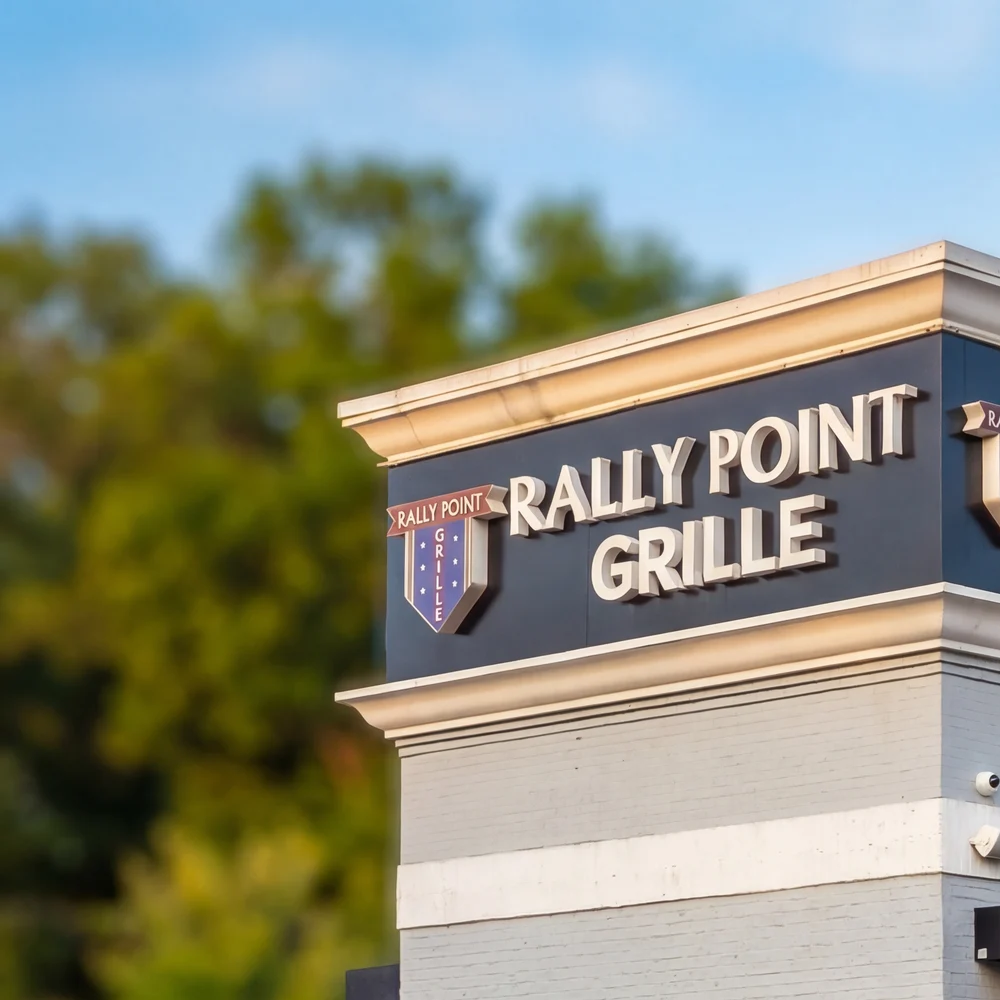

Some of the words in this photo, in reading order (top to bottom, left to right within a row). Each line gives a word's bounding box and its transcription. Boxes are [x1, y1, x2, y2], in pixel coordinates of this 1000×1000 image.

[398, 502, 437, 529] RALLY
[441, 493, 483, 519] POINT
[509, 436, 697, 537] RALLY
[709, 384, 918, 495] POINT
[434, 528, 445, 622] GRILLE
[591, 493, 827, 602] GRILLE
